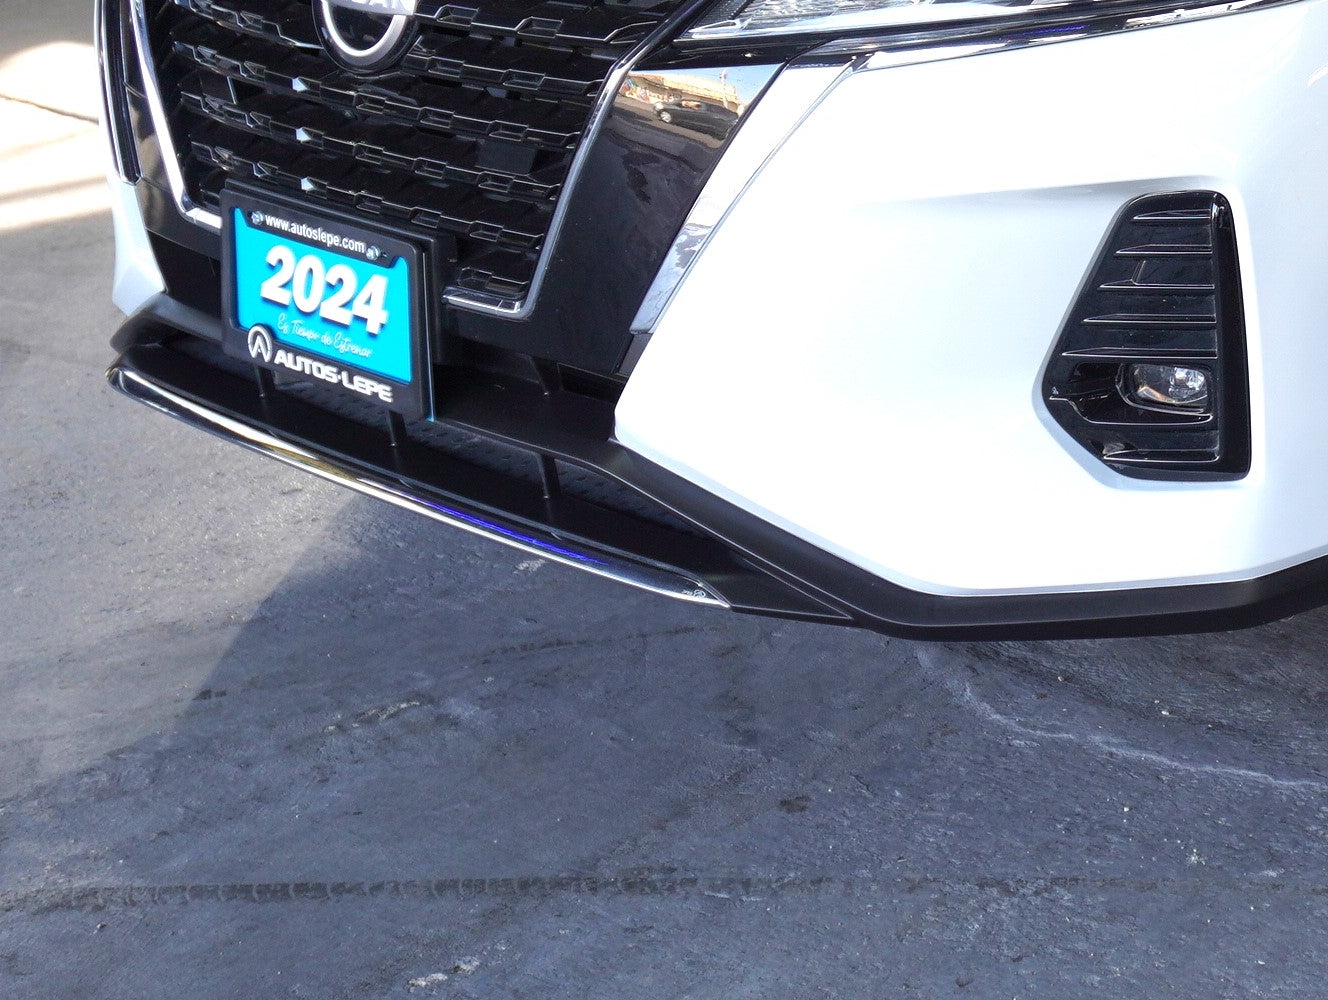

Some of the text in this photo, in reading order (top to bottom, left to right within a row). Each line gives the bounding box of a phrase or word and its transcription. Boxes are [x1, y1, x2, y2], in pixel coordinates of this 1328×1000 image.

[265, 213, 367, 254] www.autoslepe.com
[260, 244, 389, 335] 2024
[320, 330, 333, 347] de
